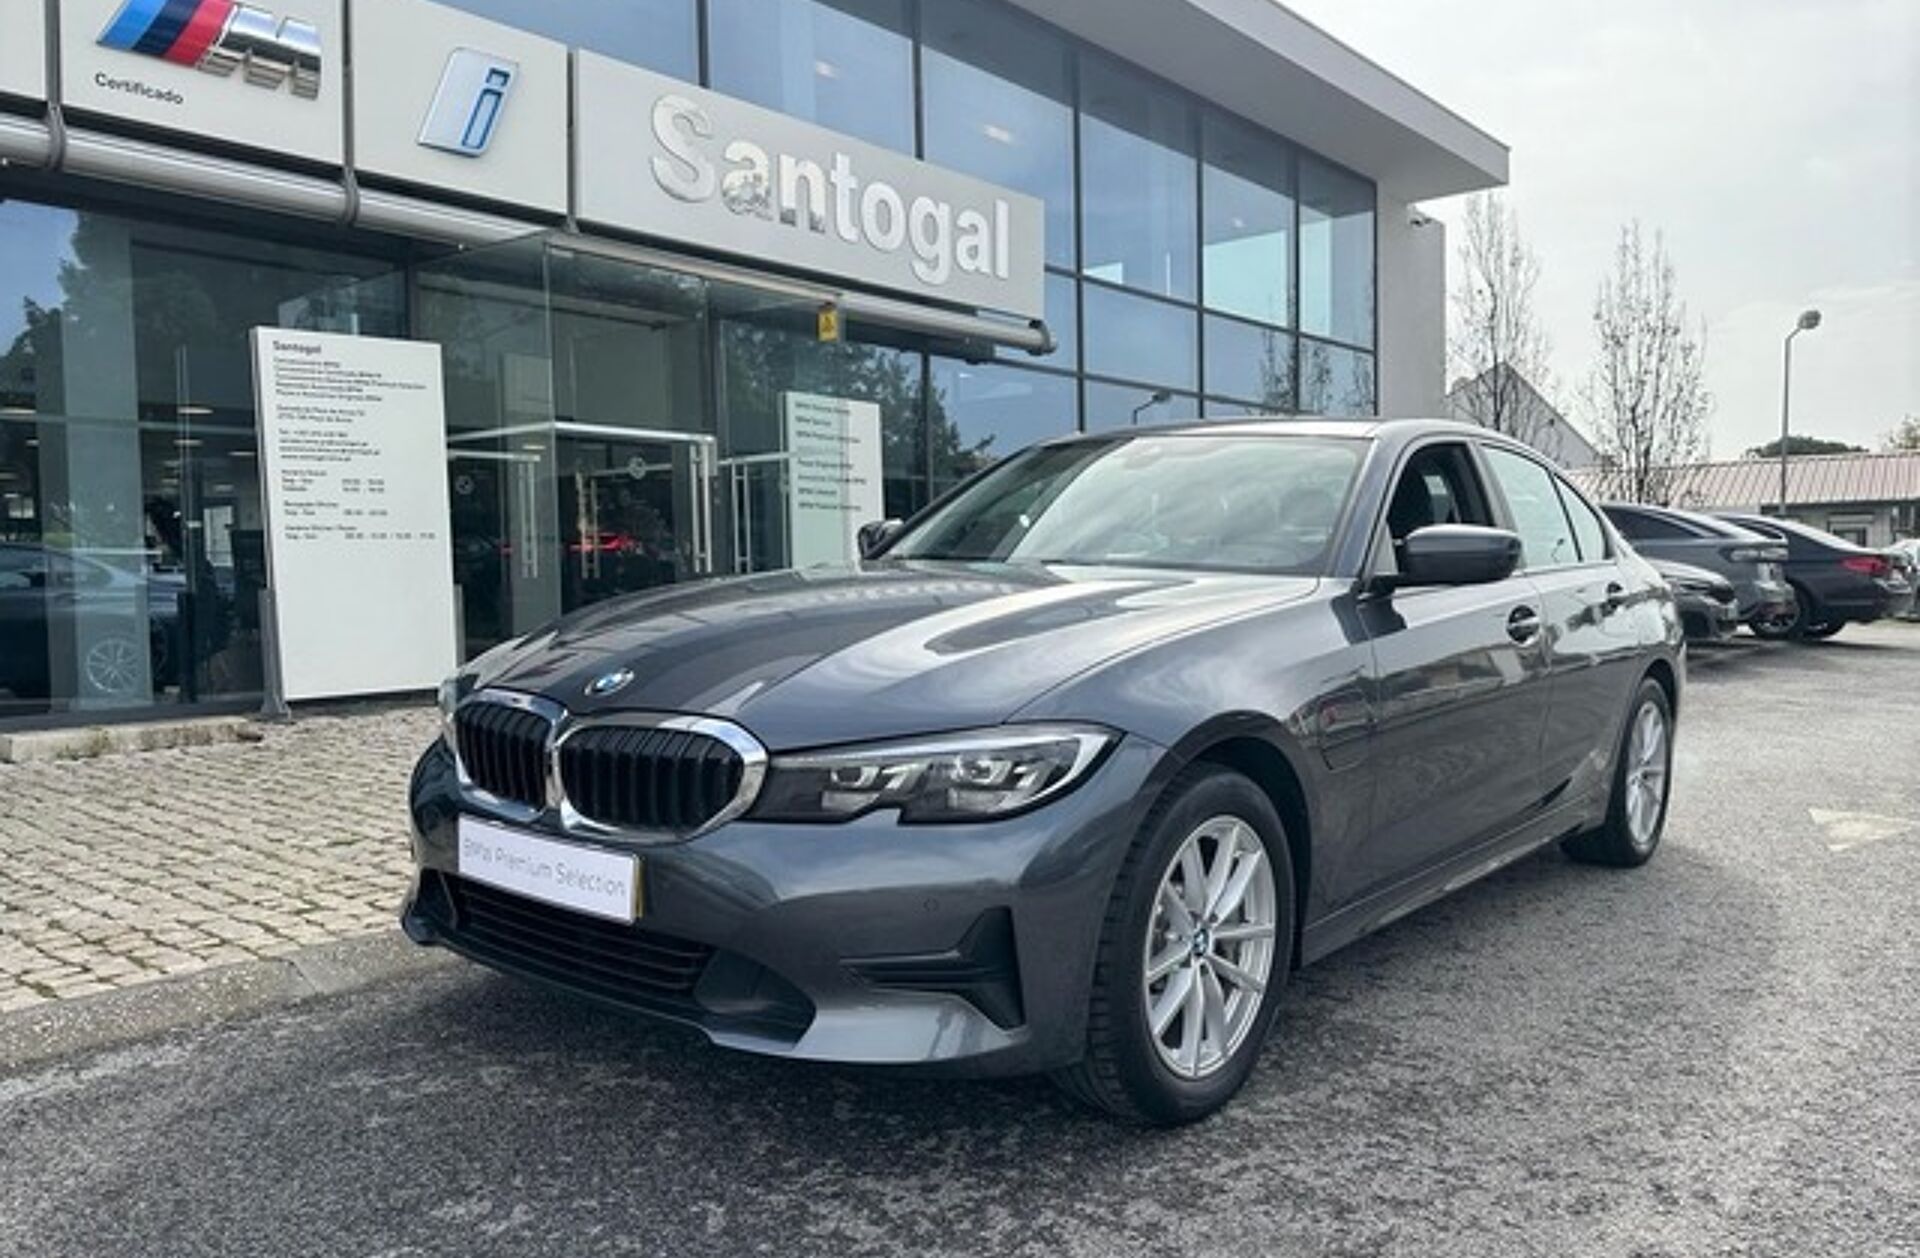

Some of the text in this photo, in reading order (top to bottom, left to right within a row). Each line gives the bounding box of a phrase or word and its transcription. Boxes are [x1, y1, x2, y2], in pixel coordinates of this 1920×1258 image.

[95, 71, 184, 105] Certificado
[650, 94, 1010, 286] Santogal
[272, 340, 322, 355] Santogal
[495, 847, 553, 878] Premium
[555, 861, 626, 898] Selection
